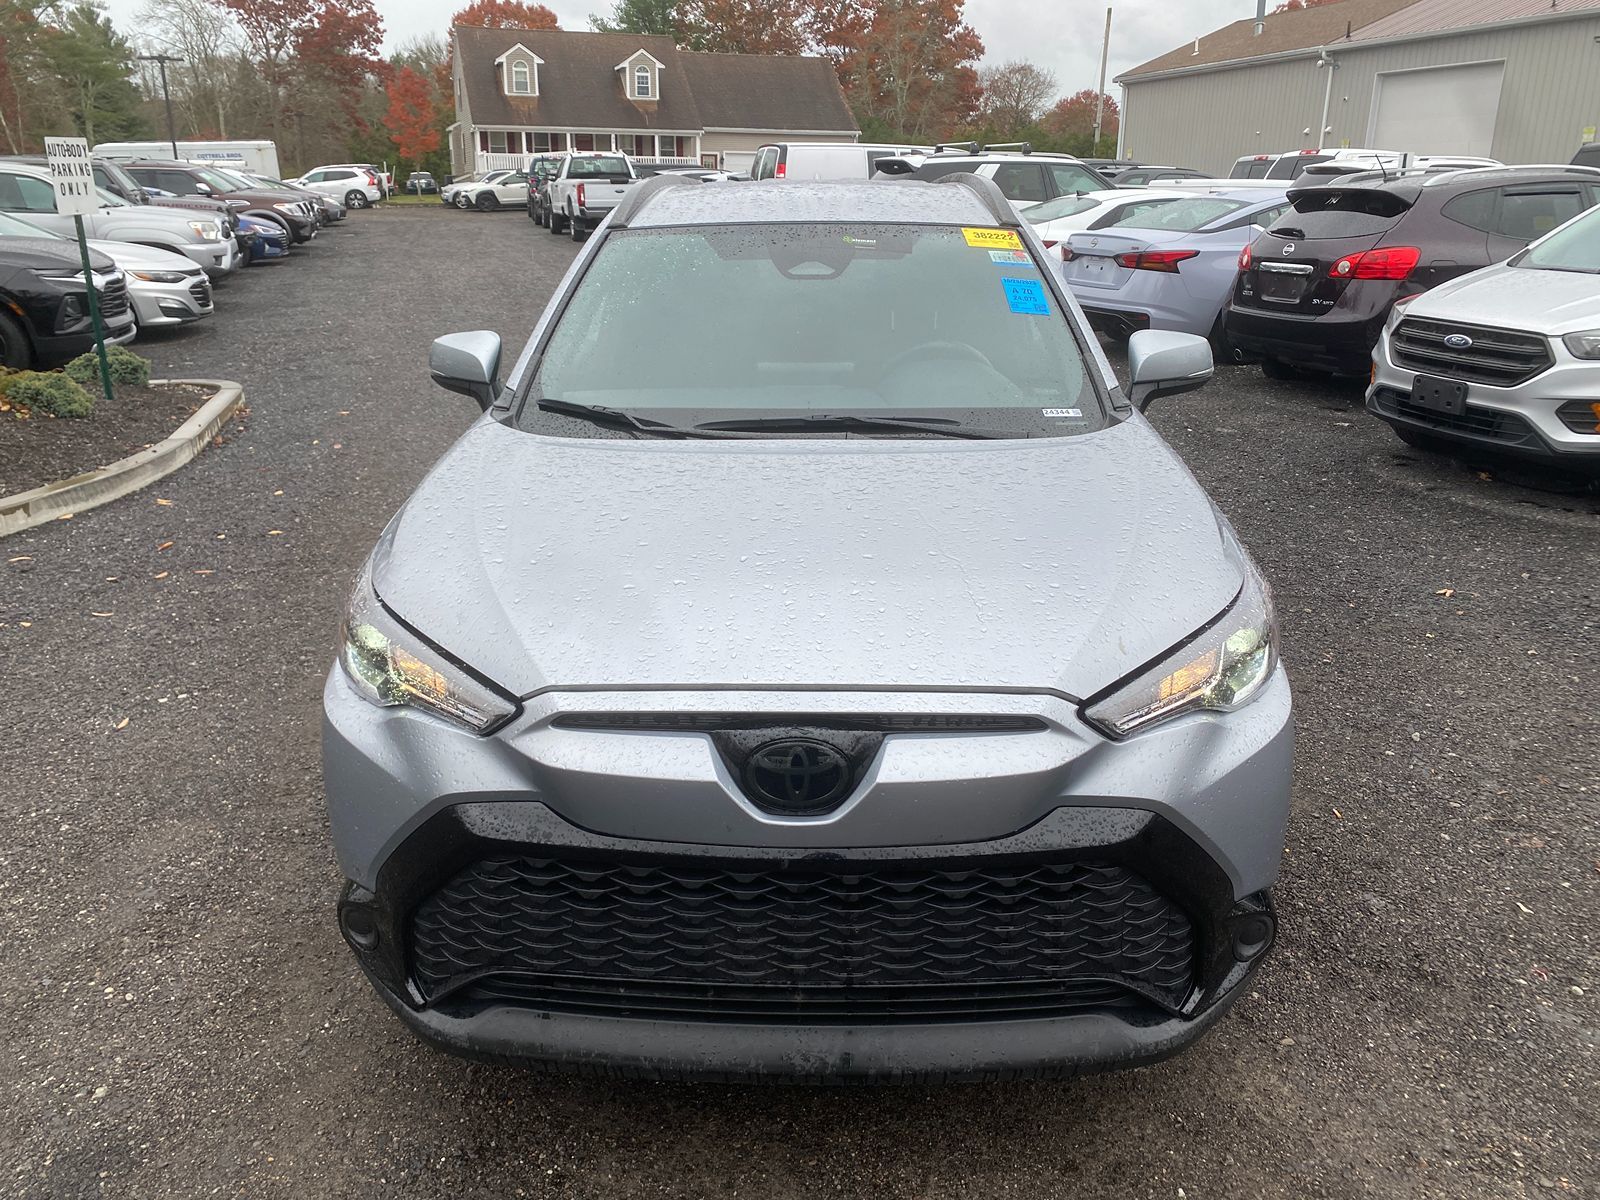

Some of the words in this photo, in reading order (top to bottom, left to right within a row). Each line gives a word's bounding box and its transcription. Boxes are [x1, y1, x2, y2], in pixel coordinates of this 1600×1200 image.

[51, 163, 91, 177] PARKING
[60, 182, 88, 196] ONLY
[973, 231, 1015, 241] 382222
